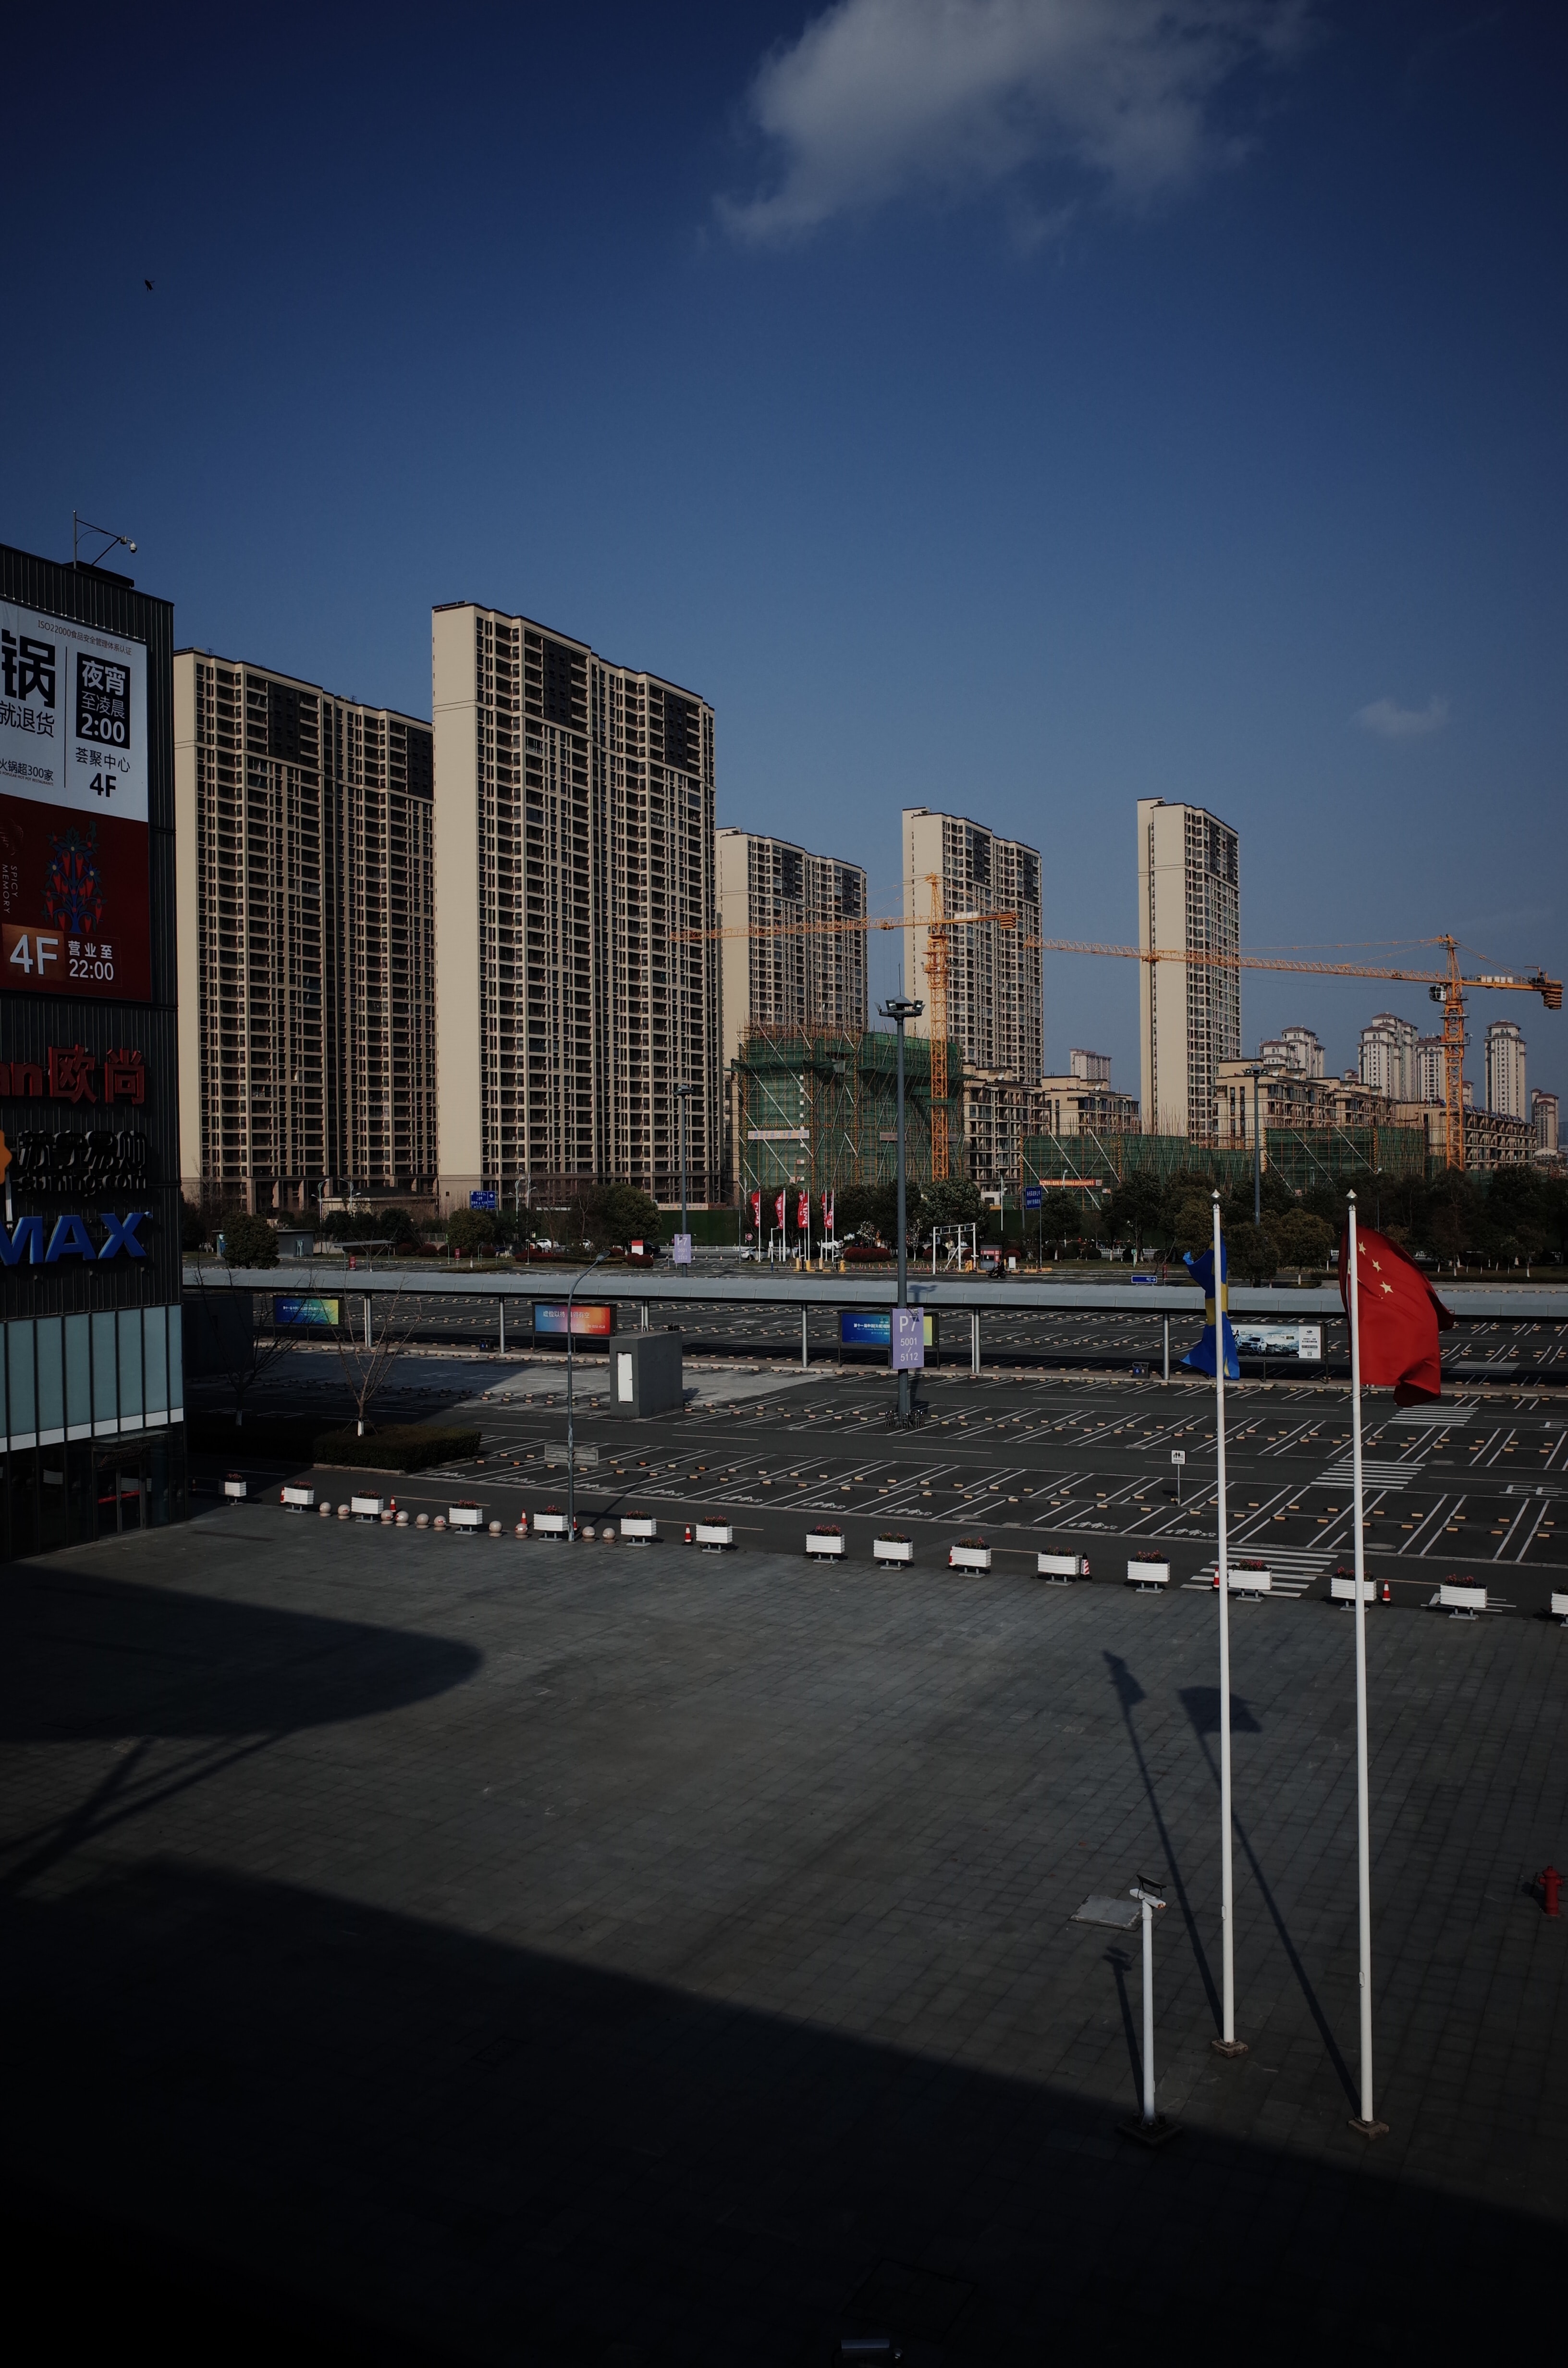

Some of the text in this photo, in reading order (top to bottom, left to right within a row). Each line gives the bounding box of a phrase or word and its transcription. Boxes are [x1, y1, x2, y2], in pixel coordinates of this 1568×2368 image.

[38, 620, 132, 655] ISO22000食品安全管理体系认证
[1, 629, 55, 709] 锅
[81, 660, 125, 696] 夜宵
[0, 701, 54, 738] 就退货
[81, 691, 125, 719] 至凌晨
[81, 713, 125, 743] 2:00
[0, 758, 53, 781] 火锅超300家
[75, 747, 130, 773] 荟聚中心
[90, 773, 116, 797] 4F
[2, 863, 11, 913] MEMORY
[11, 865, 19, 898] SPICY
[10, 934, 59, 975] 4F
[68, 940, 113, 960] 营业至
[69, 958, 114, 981] 22:00
[49, 1043, 145, 1104] 欧尚
[900, 1316, 918, 1332] P7
[900, 1337, 917, 1346] 5001
[900, 1352, 918, 1361] 5112
